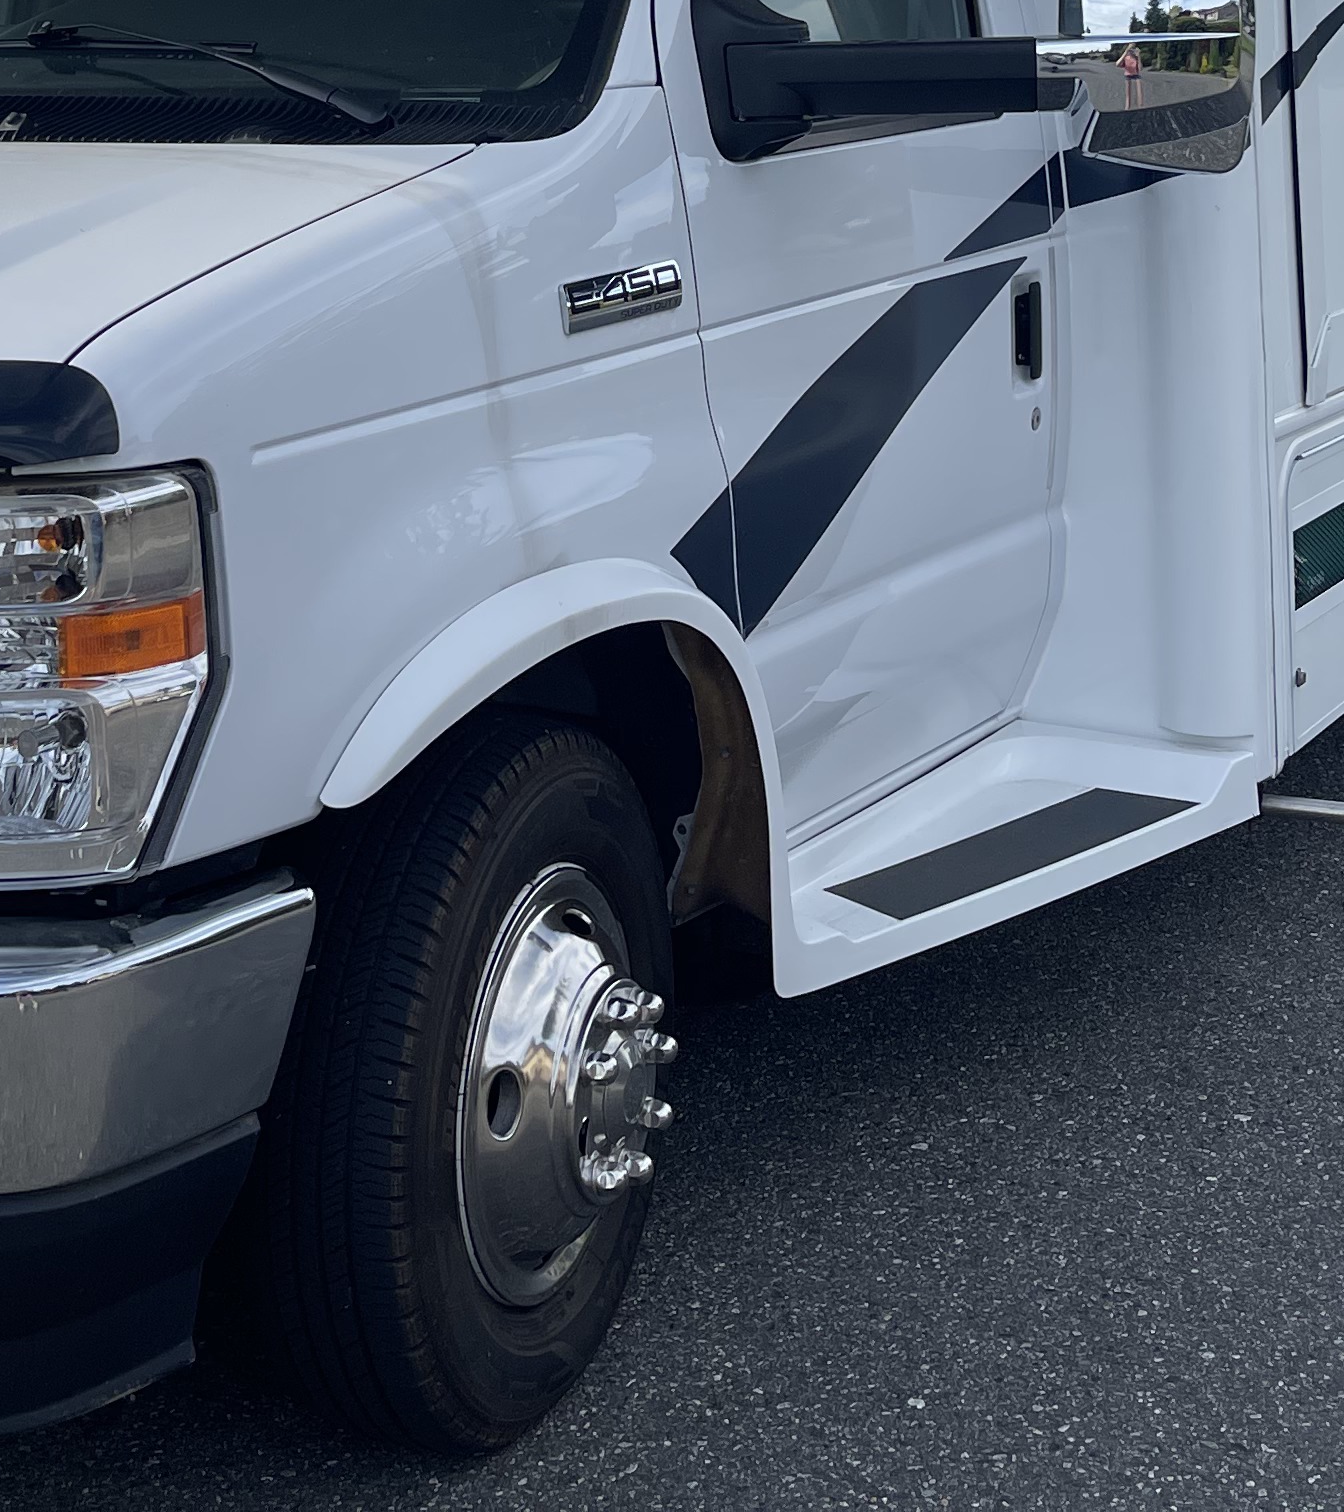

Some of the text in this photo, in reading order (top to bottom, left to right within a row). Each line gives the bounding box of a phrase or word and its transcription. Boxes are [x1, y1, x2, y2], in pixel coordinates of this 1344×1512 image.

[569, 264, 680, 315] E-450
[621, 296, 681, 318] SUPER DUTY
